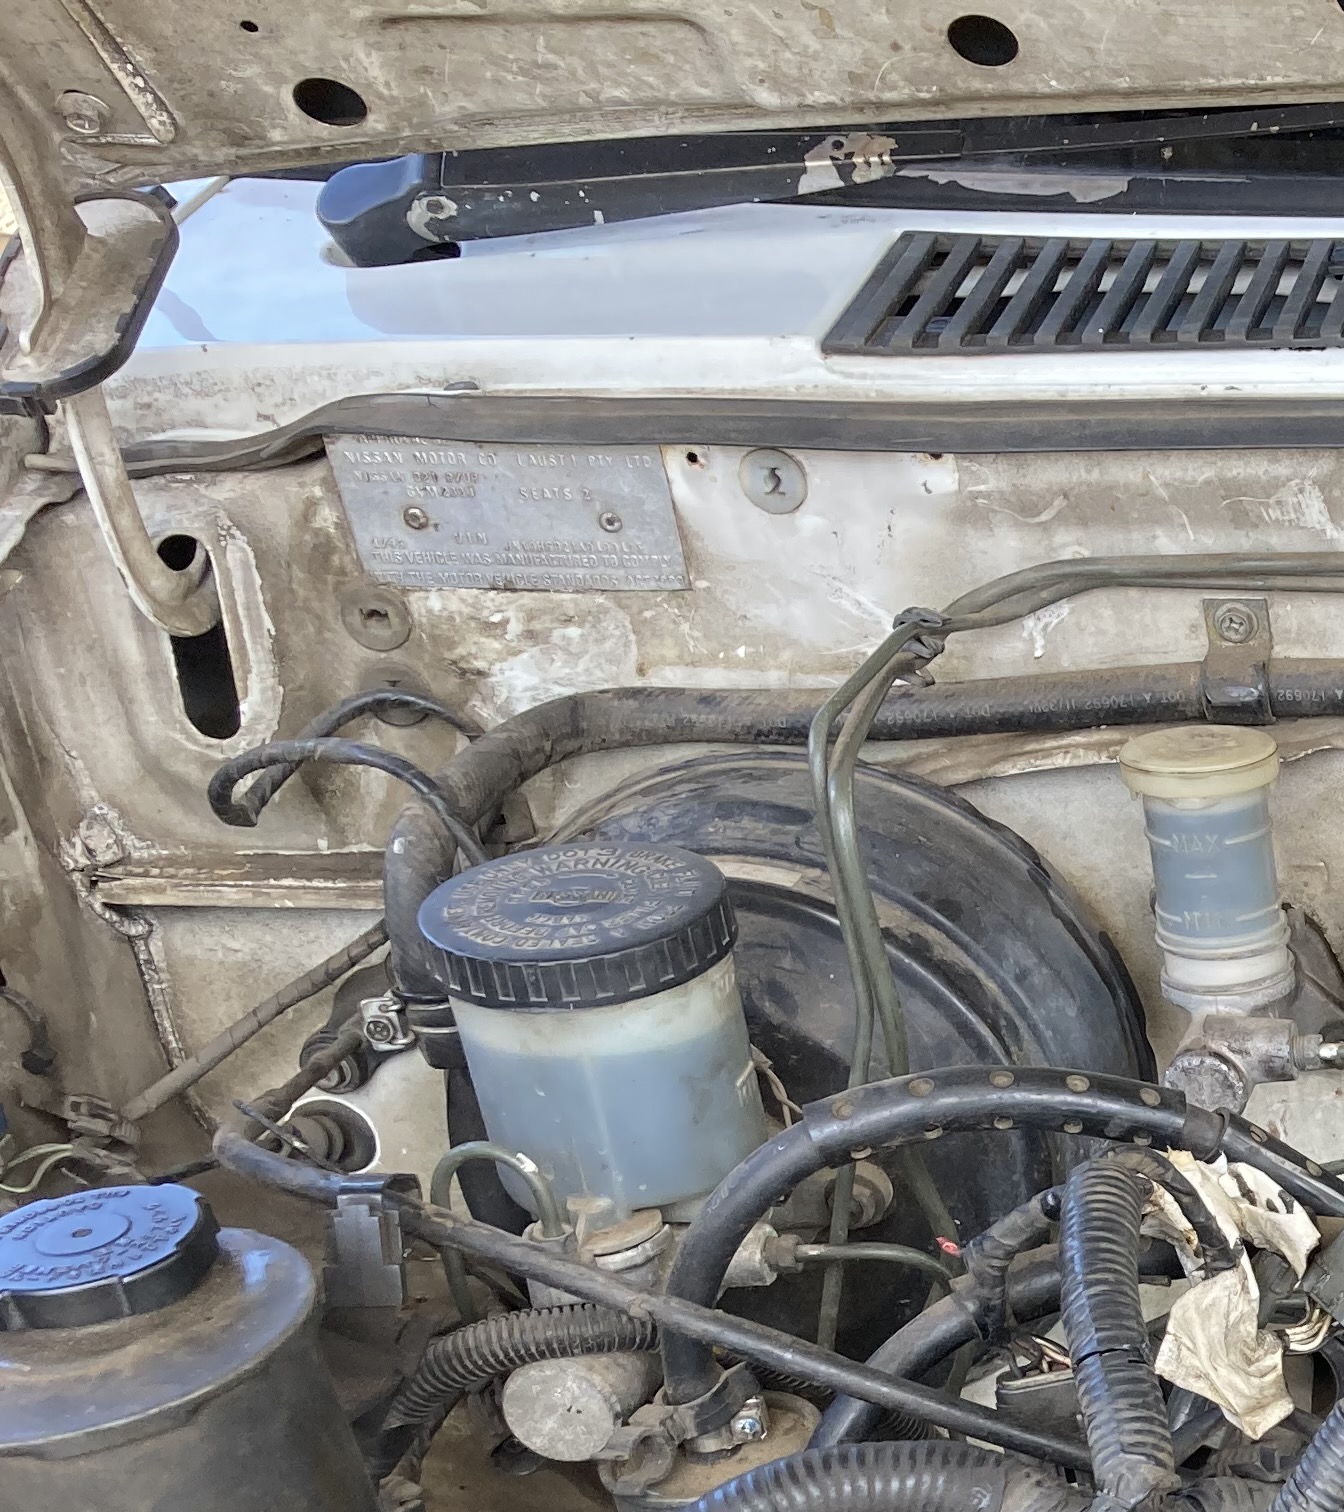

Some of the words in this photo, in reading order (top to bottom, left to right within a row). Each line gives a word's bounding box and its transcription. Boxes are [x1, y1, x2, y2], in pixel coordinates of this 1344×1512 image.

[343, 451, 403, 464] NISSAN
[413, 452, 467, 465] MOTOR
[478, 453, 497, 465] CO
[588, 455, 613, 467] PTY
[626, 455, 652, 468] LTD
[519, 487, 572, 499] SEATS
[371, 552, 402, 565] THIS
[405, 552, 460, 565] VEHICLE
[463, 552, 492, 565] WAS
[496, 553, 598, 567] MANUFACTURED
[604, 556, 619, 567] TO
[407, 571, 433, 584] THE
[437, 572, 483, 585] MOTOR
[543, 574, 618, 587] STANDARDS
[1161, 690, 1186, 703] DOT
[1171, 832, 1220, 853] MAX
[480, 858, 532, 880] ONLY
[629, 849, 687, 870] BRAKE
[527, 858, 651, 876] WARNING
